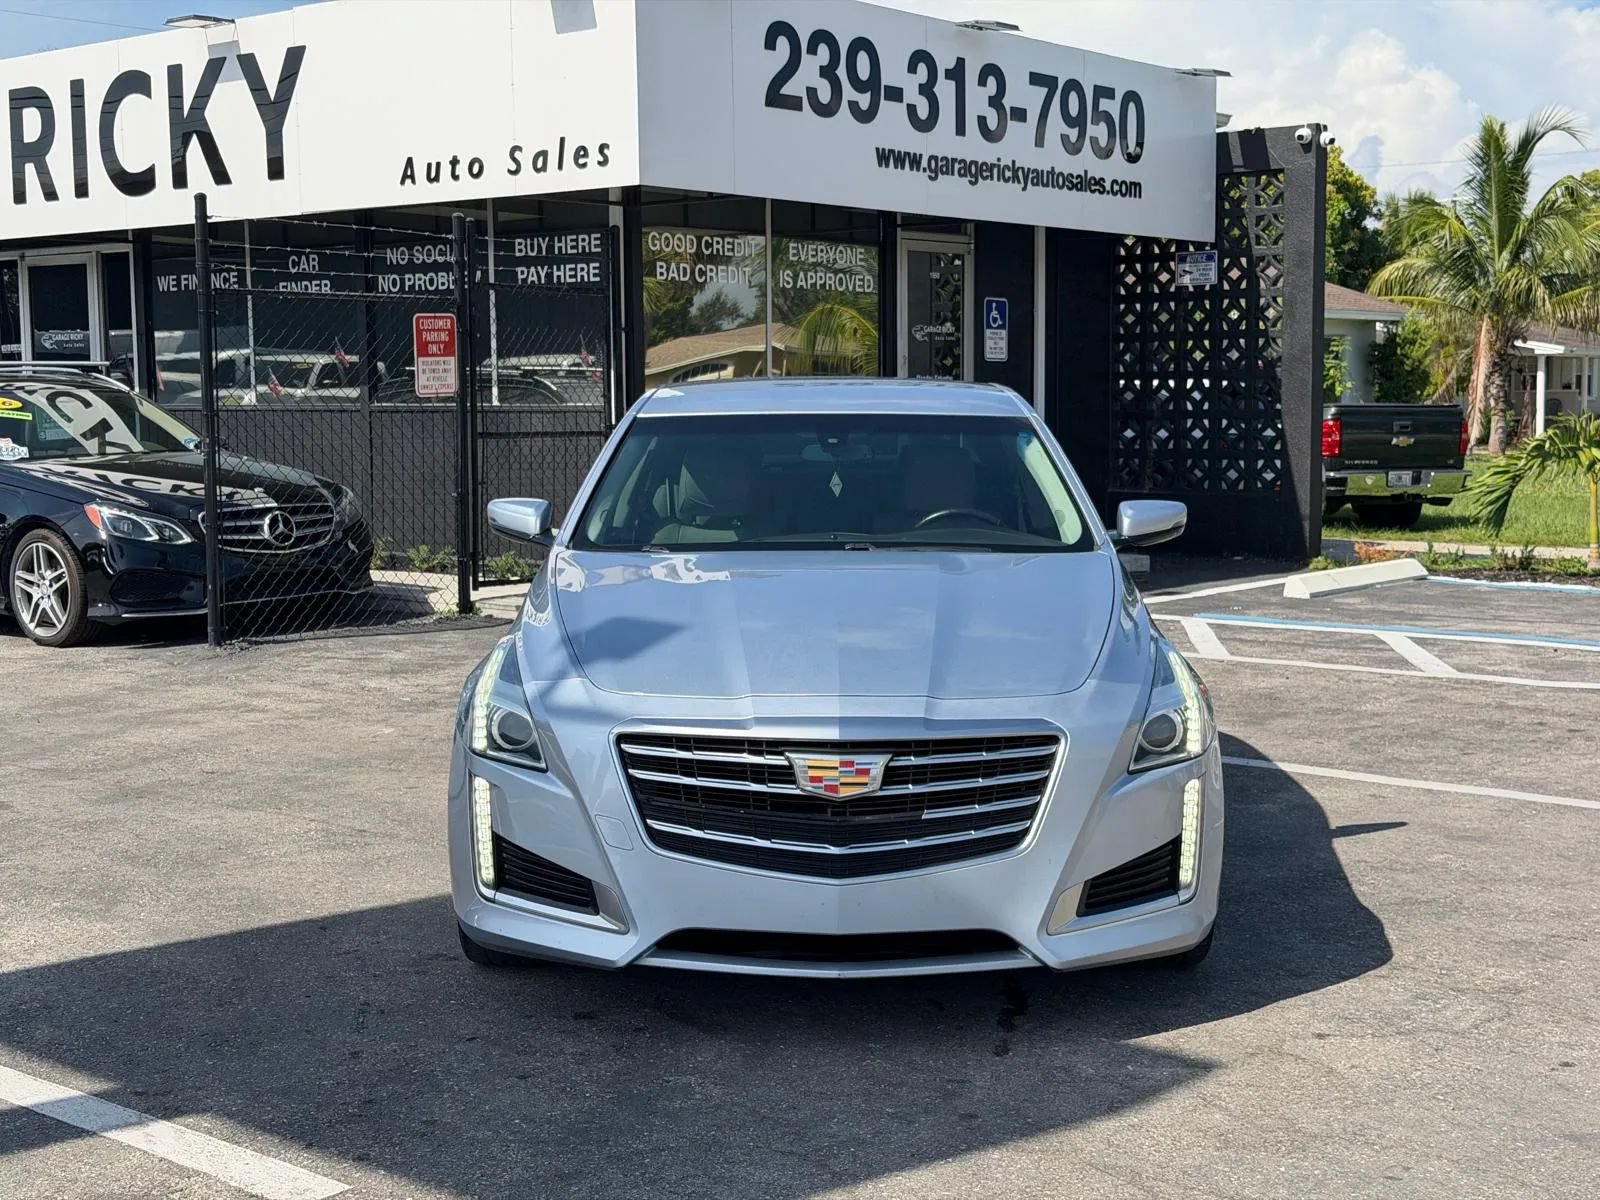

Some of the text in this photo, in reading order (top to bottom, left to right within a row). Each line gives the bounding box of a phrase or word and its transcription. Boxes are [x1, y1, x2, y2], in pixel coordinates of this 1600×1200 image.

[763, 20, 1146, 165] 239-313-7950
[8, 44, 307, 206] RICKY
[400, 136, 611, 187] Auto Sales
[875, 144, 1143, 199] www.garagerickyautosales.com
[386, 247, 408, 266] NO
[515, 233, 602, 257] BUY HERE
[648, 231, 756, 258] GOOD CREDIT
[788, 242, 865, 266] EVERYONE
[288, 254, 319, 273] CAR
[517, 262, 601, 285] PAY HERE
[656, 261, 752, 286] BAD CREDIT
[156, 271, 240, 293] WE FINNCE
[378, 274, 400, 293] NO
[779, 269, 874, 293] IS APPROVED
[419, 318, 451, 330] CUSTOMER
[422, 331, 449, 342] PARKING
[427, 343, 445, 355] ONLY
